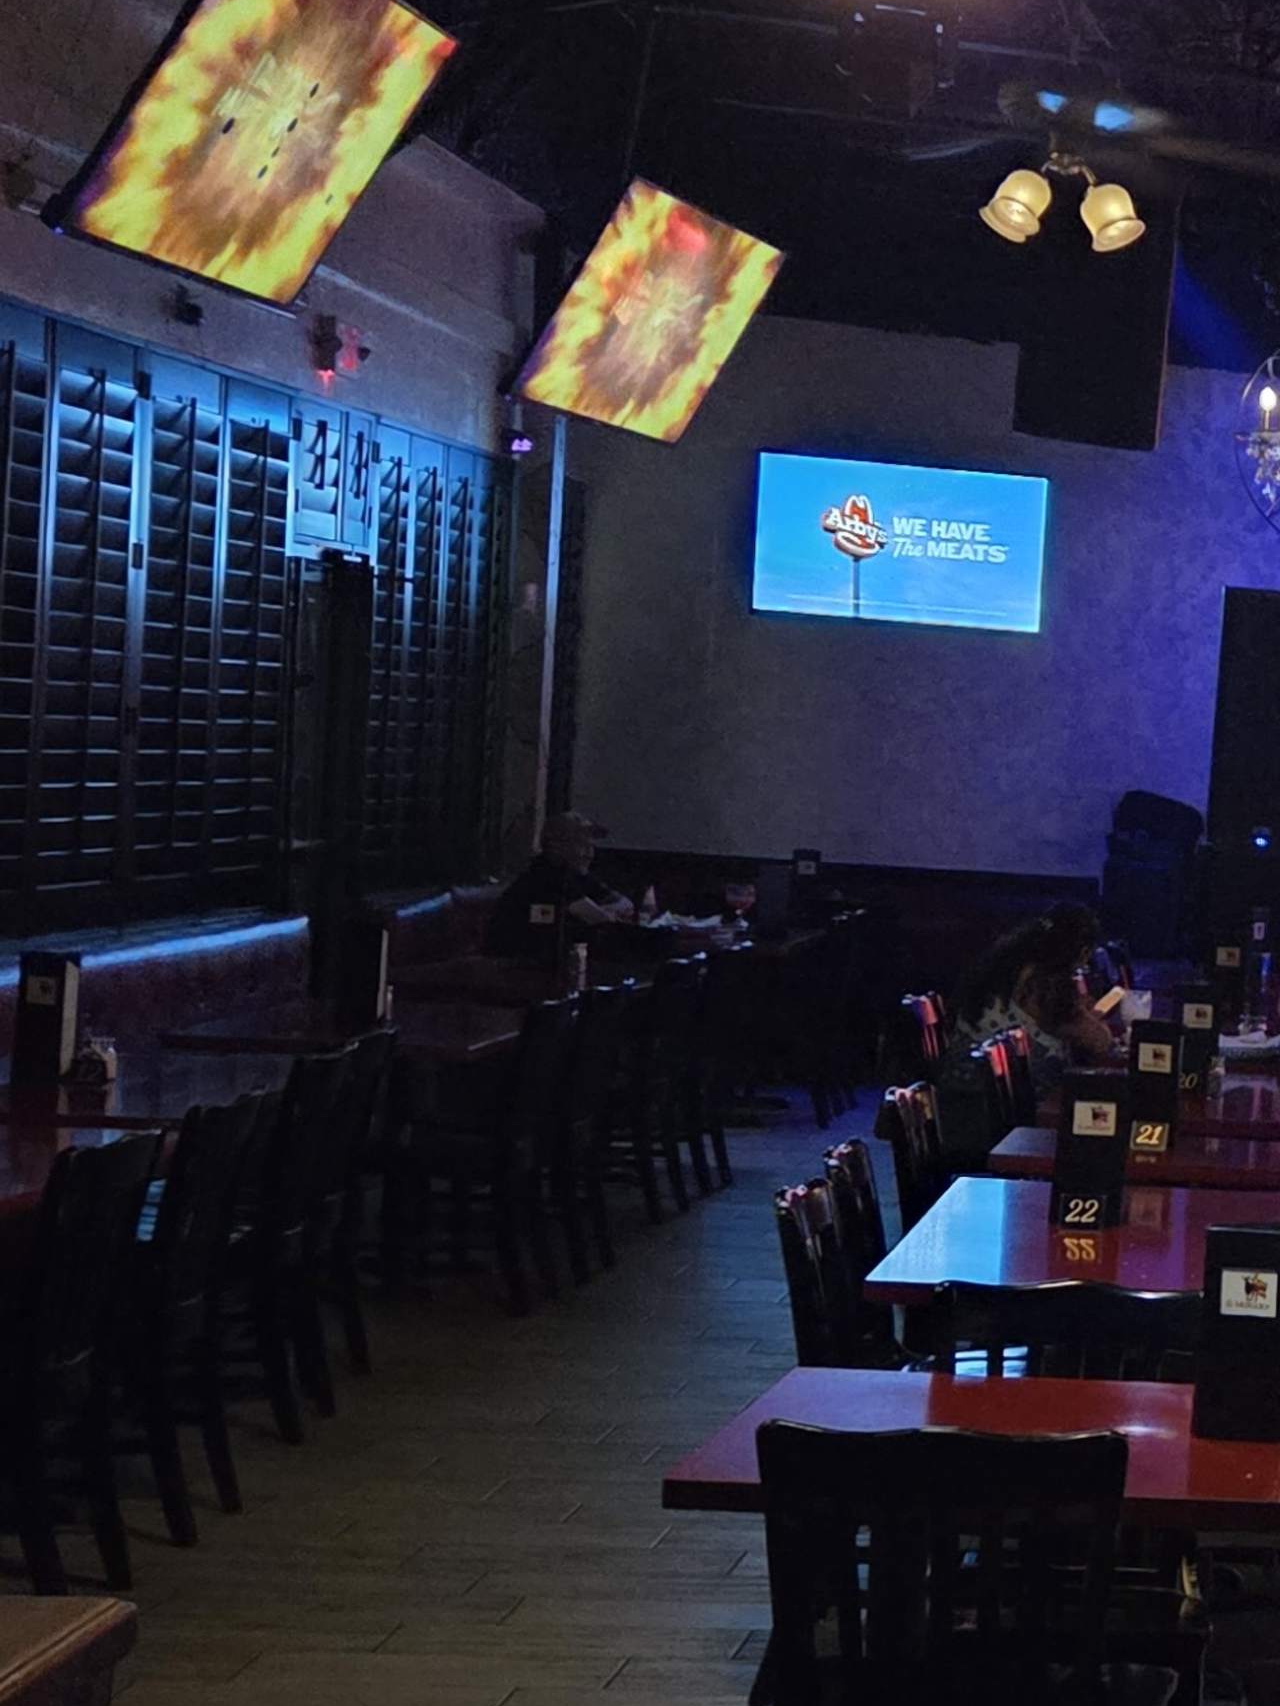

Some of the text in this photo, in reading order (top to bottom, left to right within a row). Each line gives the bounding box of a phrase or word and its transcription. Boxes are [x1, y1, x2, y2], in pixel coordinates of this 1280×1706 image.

[893, 517, 991, 542] WE HAVE
[892, 537, 1008, 563] The MEATS
[1136, 1125, 1163, 1145] 21
[1064, 1198, 1099, 1223] 22
